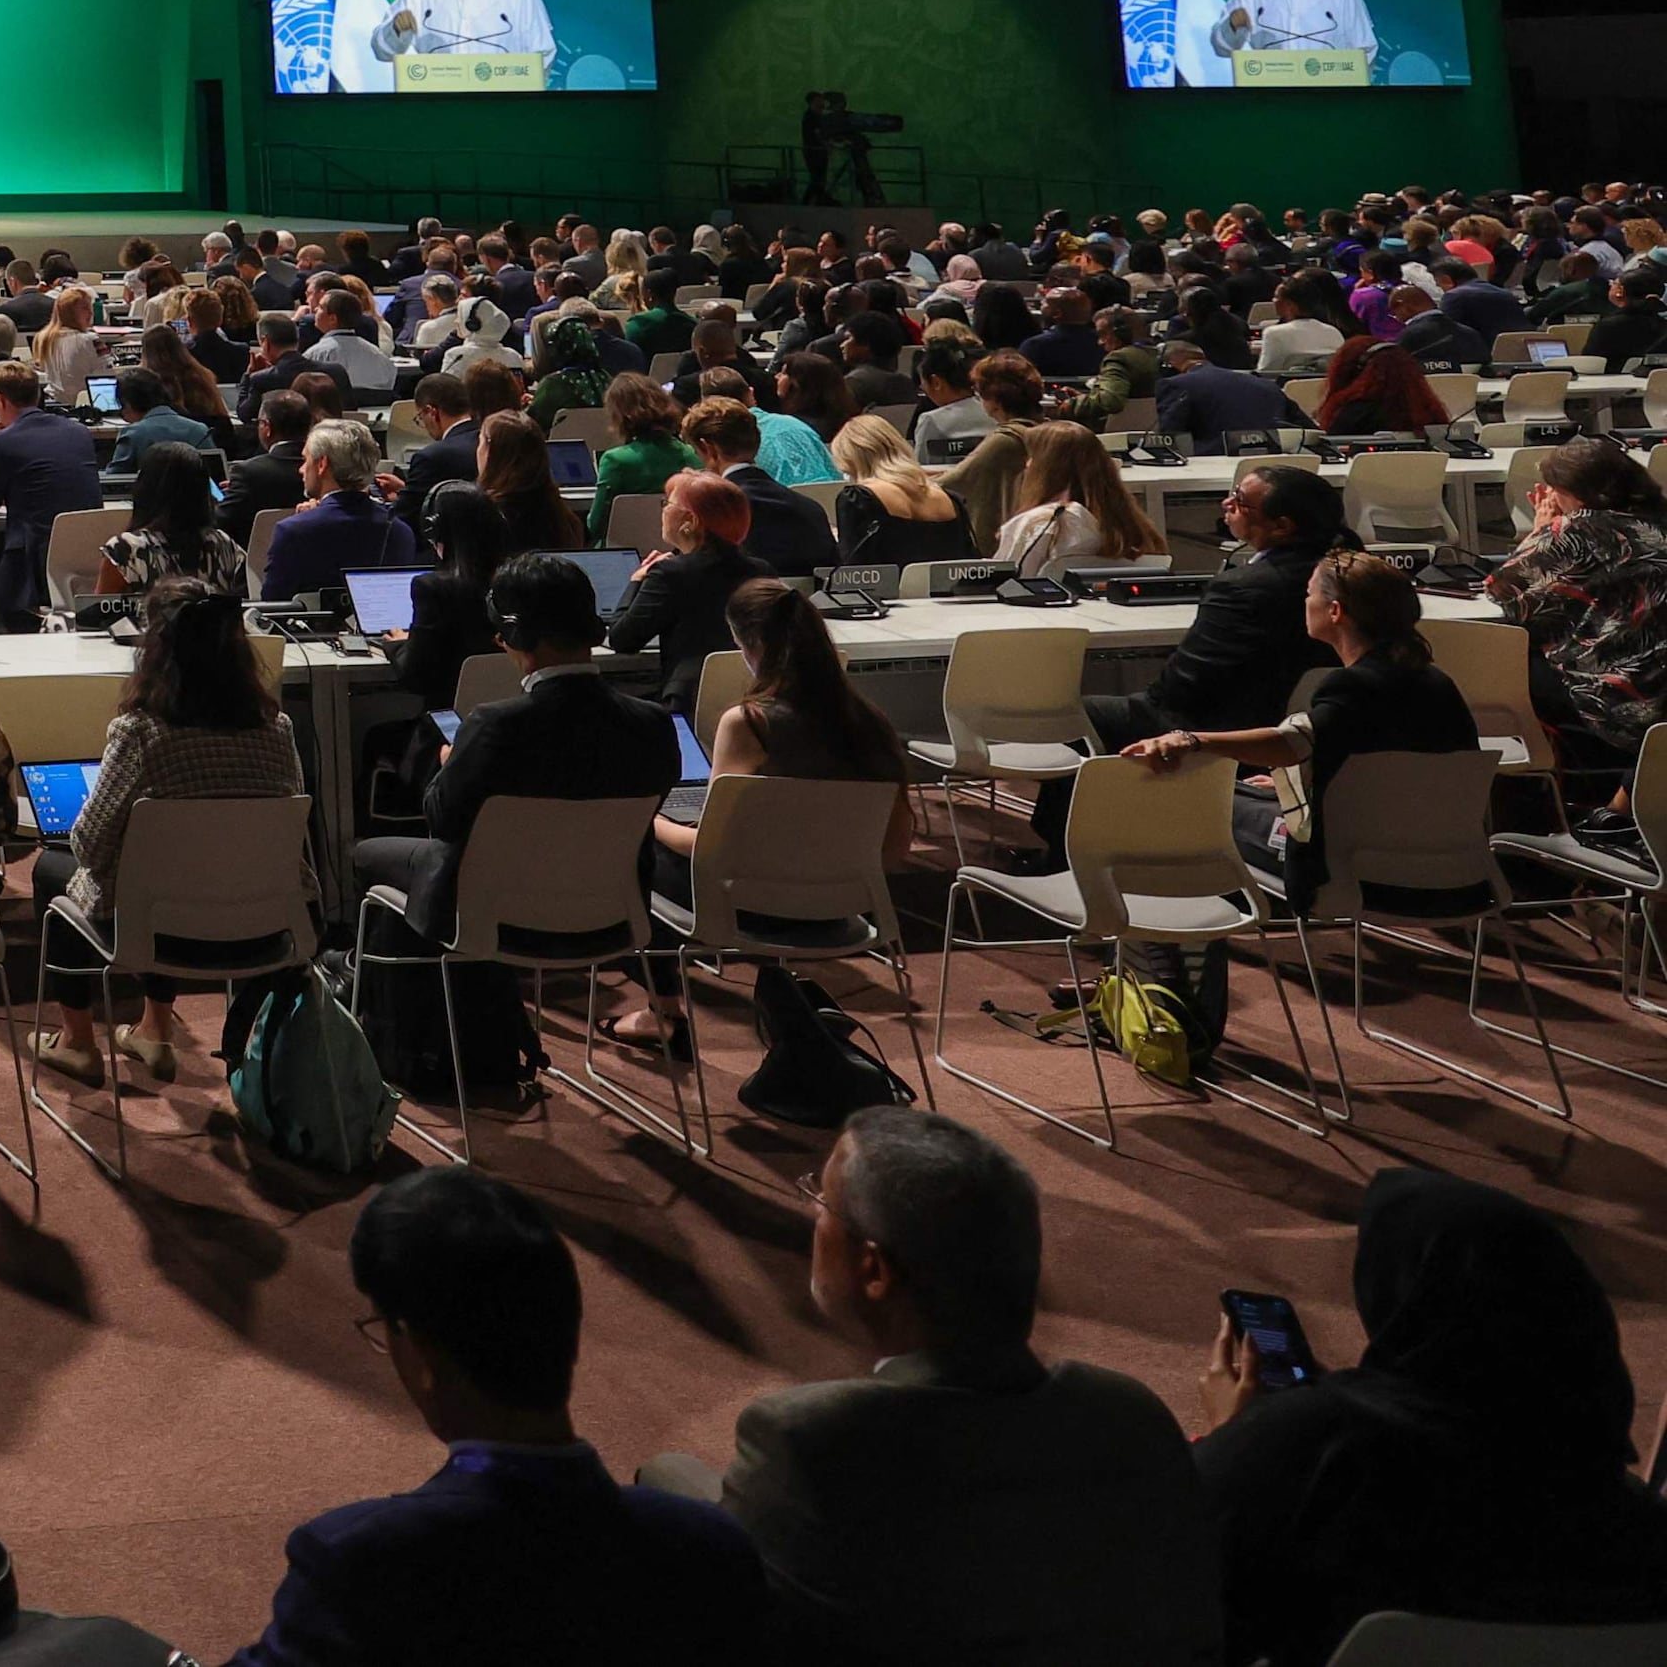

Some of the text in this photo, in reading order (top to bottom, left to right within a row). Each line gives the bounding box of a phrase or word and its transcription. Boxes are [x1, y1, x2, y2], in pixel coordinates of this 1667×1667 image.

[1424, 360, 1452, 370] YEMEN
[1540, 426, 1561, 436] LAS
[948, 441, 964, 453] ITF
[833, 570, 881, 585] UNCCD
[948, 565, 995, 581] UNCDF
